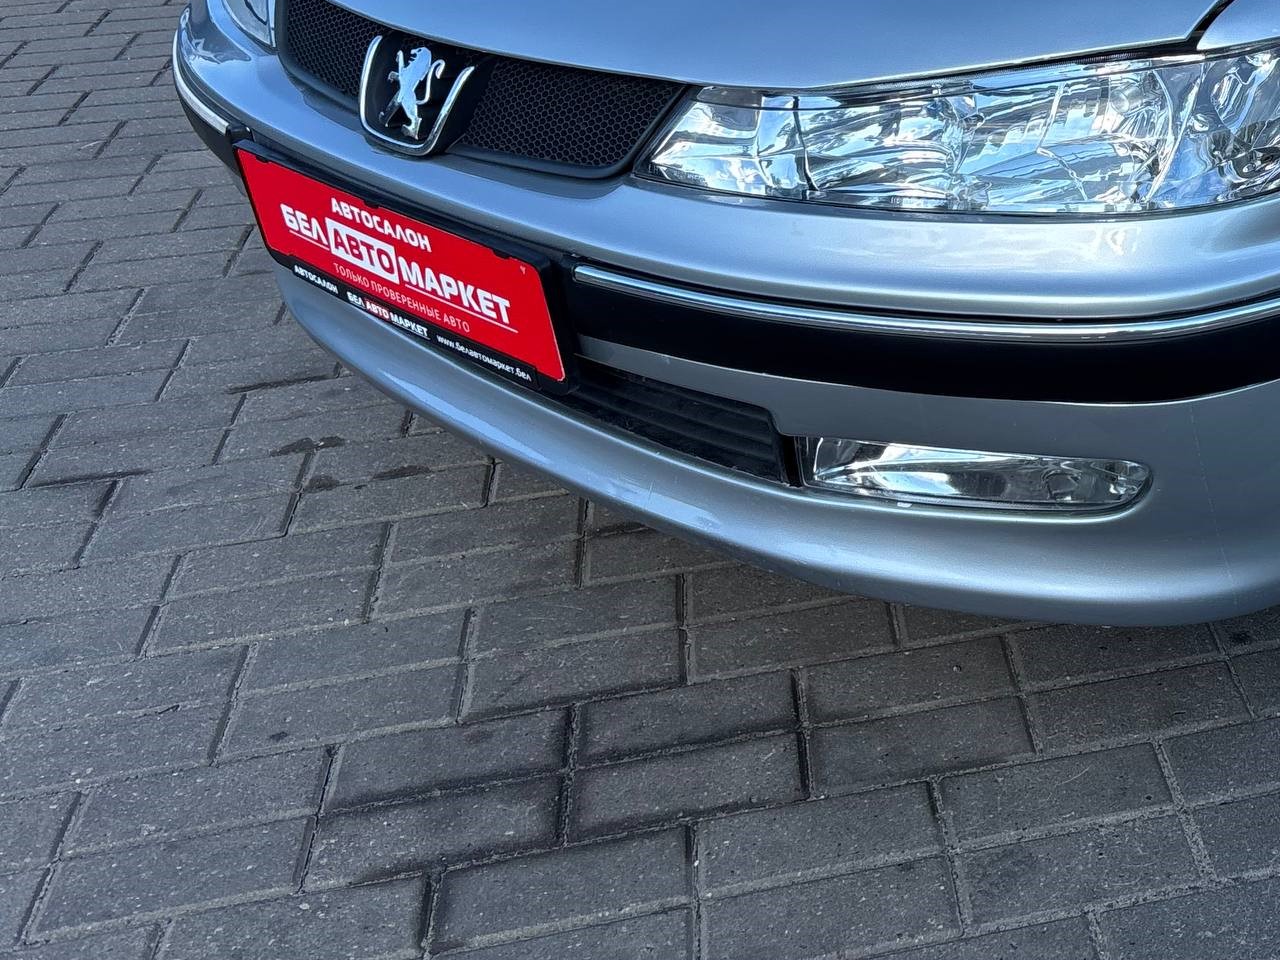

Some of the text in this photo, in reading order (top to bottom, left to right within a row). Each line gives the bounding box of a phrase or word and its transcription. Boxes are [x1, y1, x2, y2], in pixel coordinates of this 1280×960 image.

[331, 198, 432, 252] АВТОСАЛОН
[294, 265, 339, 294] АВТОСАЛОН
[347, 291, 364, 307] БЕЛ
[366, 300, 389, 319] АВТО
[390, 311, 428, 337] МАРКЕТ
[332, 227, 396, 276] АВТО
[398, 256, 511, 324] МАРКЕТ
[333, 262, 470, 333] ТОЛЬКО ПРОВЕРЕННЫЕ АВТО
